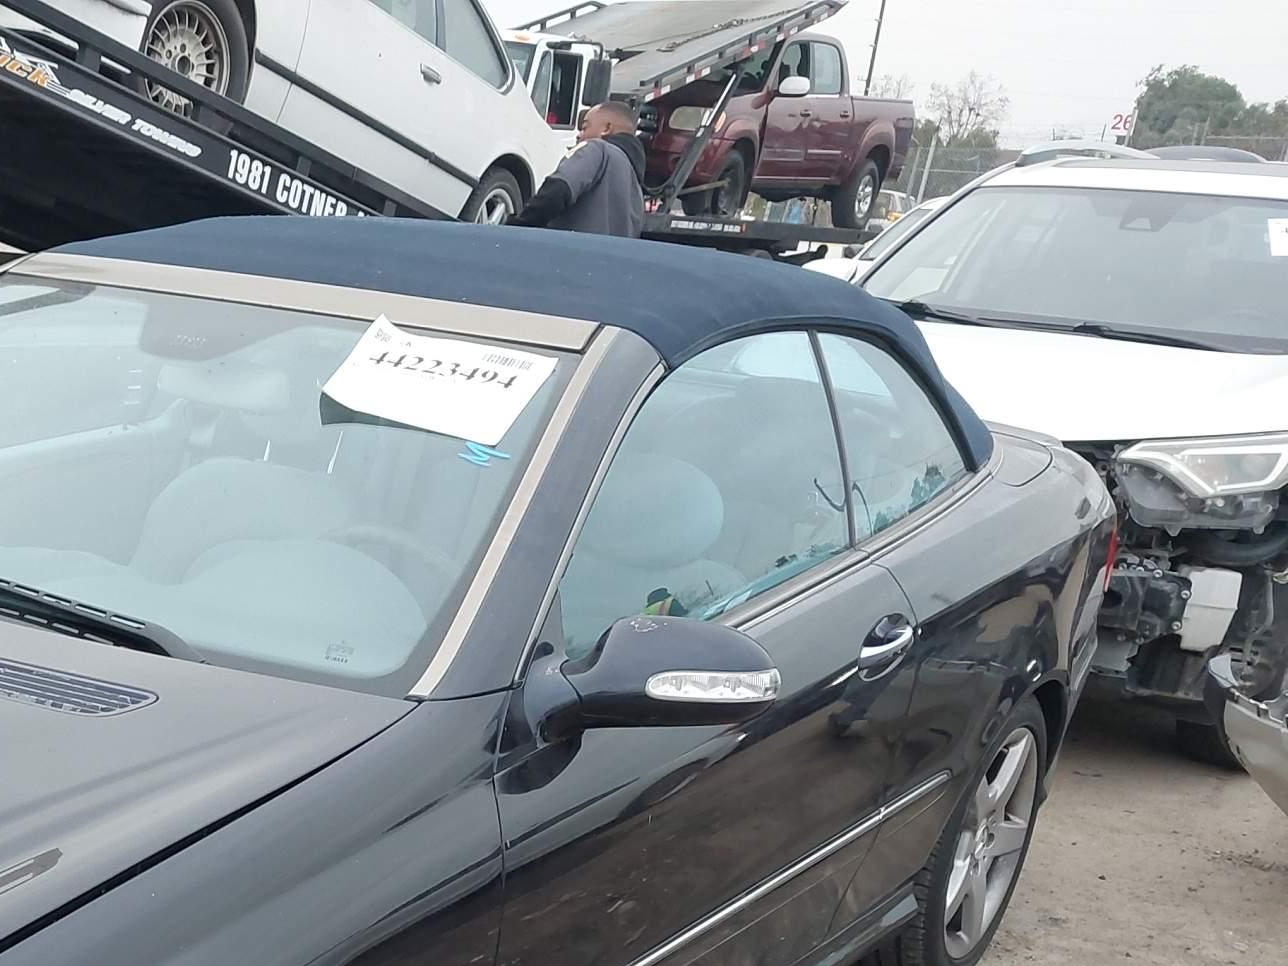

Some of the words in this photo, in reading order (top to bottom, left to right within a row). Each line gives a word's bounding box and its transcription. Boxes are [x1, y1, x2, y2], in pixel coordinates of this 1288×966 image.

[227, 149, 271, 194] 1981
[275, 173, 347, 217] COTNER
[369, 351, 518, 389] 44223494
